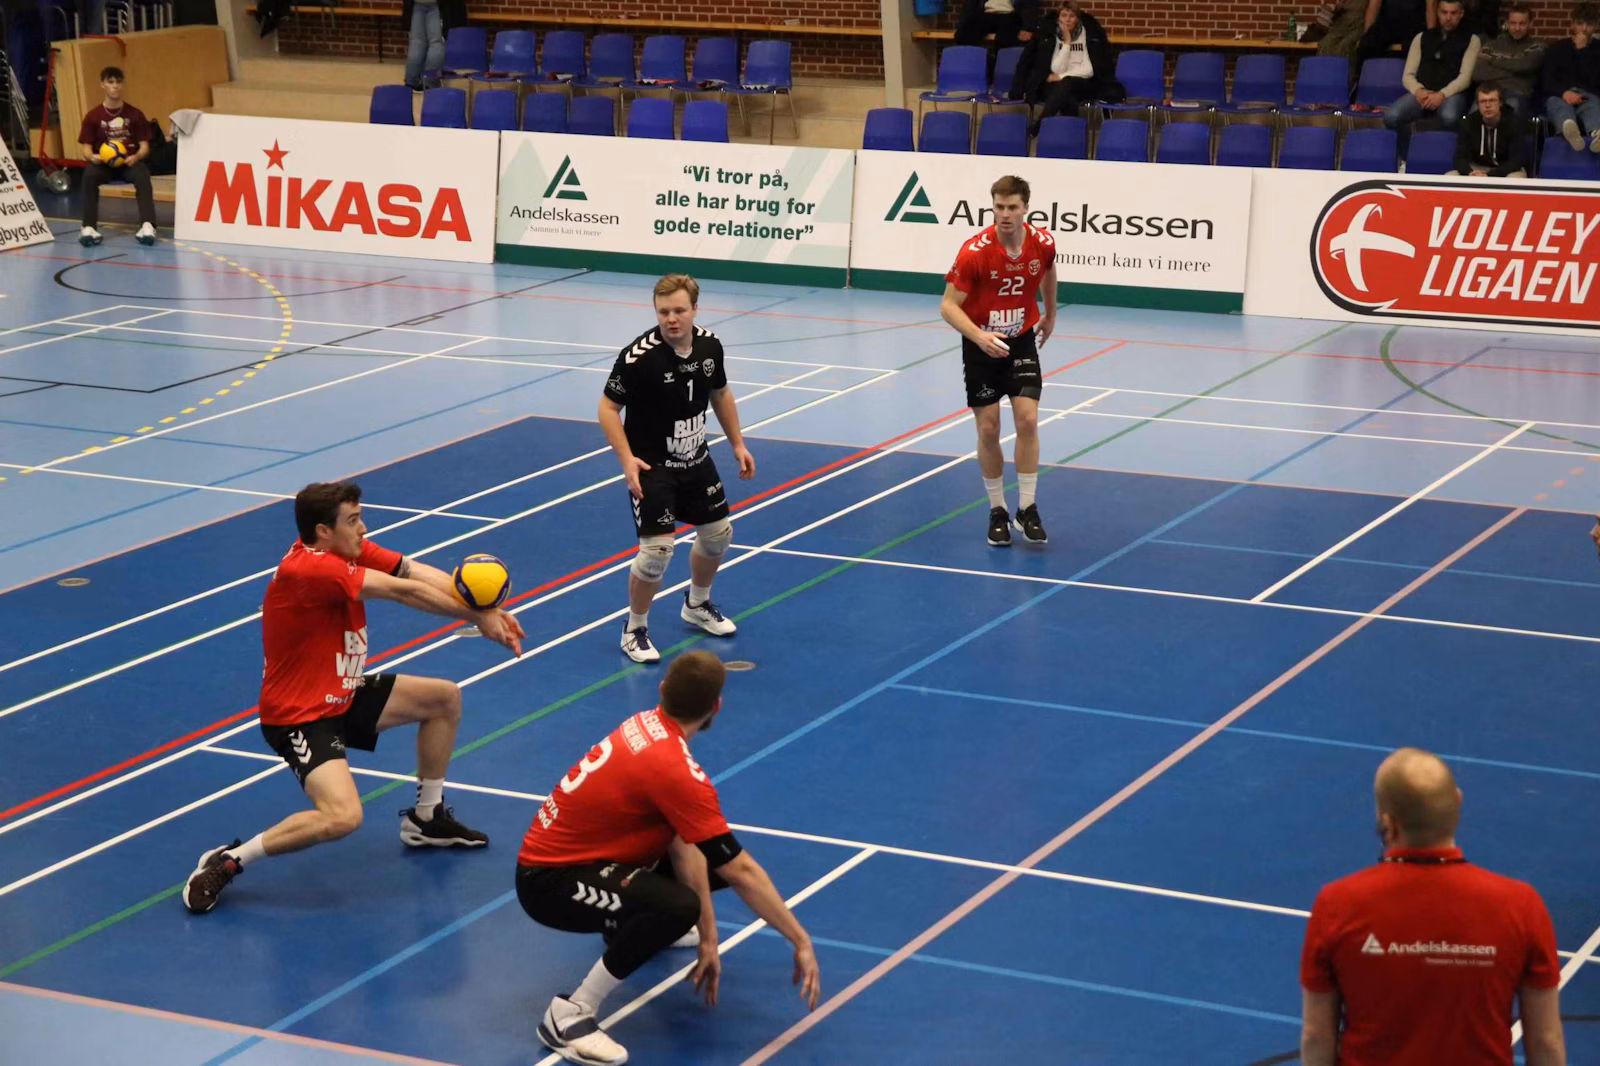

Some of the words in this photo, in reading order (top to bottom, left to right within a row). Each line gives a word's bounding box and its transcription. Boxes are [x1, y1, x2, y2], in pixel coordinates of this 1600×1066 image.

[717, 168, 753, 185] tror
[759, 169, 789, 190] på,
[0, 199, 36, 216] Varde
[655, 190, 690, 207] alle
[697, 192, 729, 209] har
[735, 195, 780, 216] brug
[787, 198, 815, 214] for
[509, 205, 620, 225] Andelskassen
[948, 200, 1214, 240] Anelskassen
[653, 217, 701, 235] gode
[1428, 206, 1600, 255] VOLLEY
[1056, 252, 1106, 267] mmen
[1112, 252, 1142, 269] kan
[1148, 256, 1161, 270] vi
[1168, 259, 1211, 272] mere
[998, 276, 1025, 296] 22
[1419, 254, 1598, 304] LIGAEN
[989, 307, 1025, 327] BLUE
[686, 379, 694, 402] 1
[1387, 940, 1498, 955] Andelskassen
